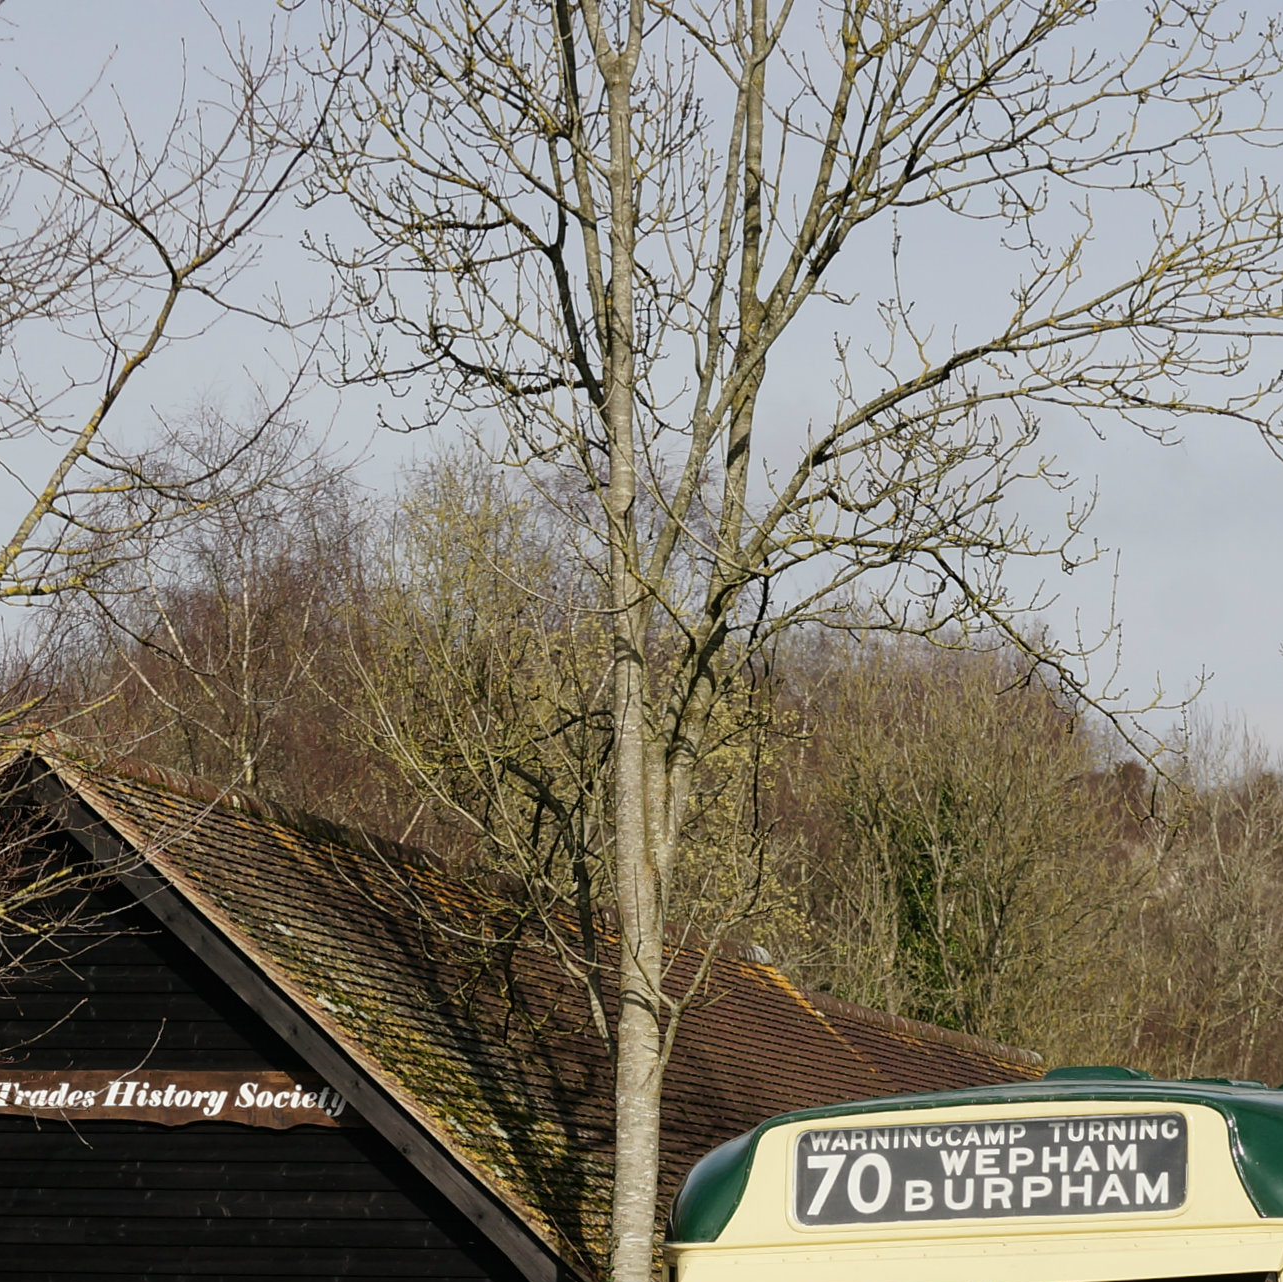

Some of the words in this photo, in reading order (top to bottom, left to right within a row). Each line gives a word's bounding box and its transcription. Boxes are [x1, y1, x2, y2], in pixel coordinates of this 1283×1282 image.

[101, 1081, 227, 1117] History
[234, 1082, 348, 1118] Society
[810, 1123, 1027, 1152] WARNINGCAMP
[1048, 1119, 1180, 1144] TURNING
[939, 1143, 1139, 1177] WEPHAM
[806, 1153, 892, 1217] 70
[904, 1172, 1170, 1213] BURPHAM
